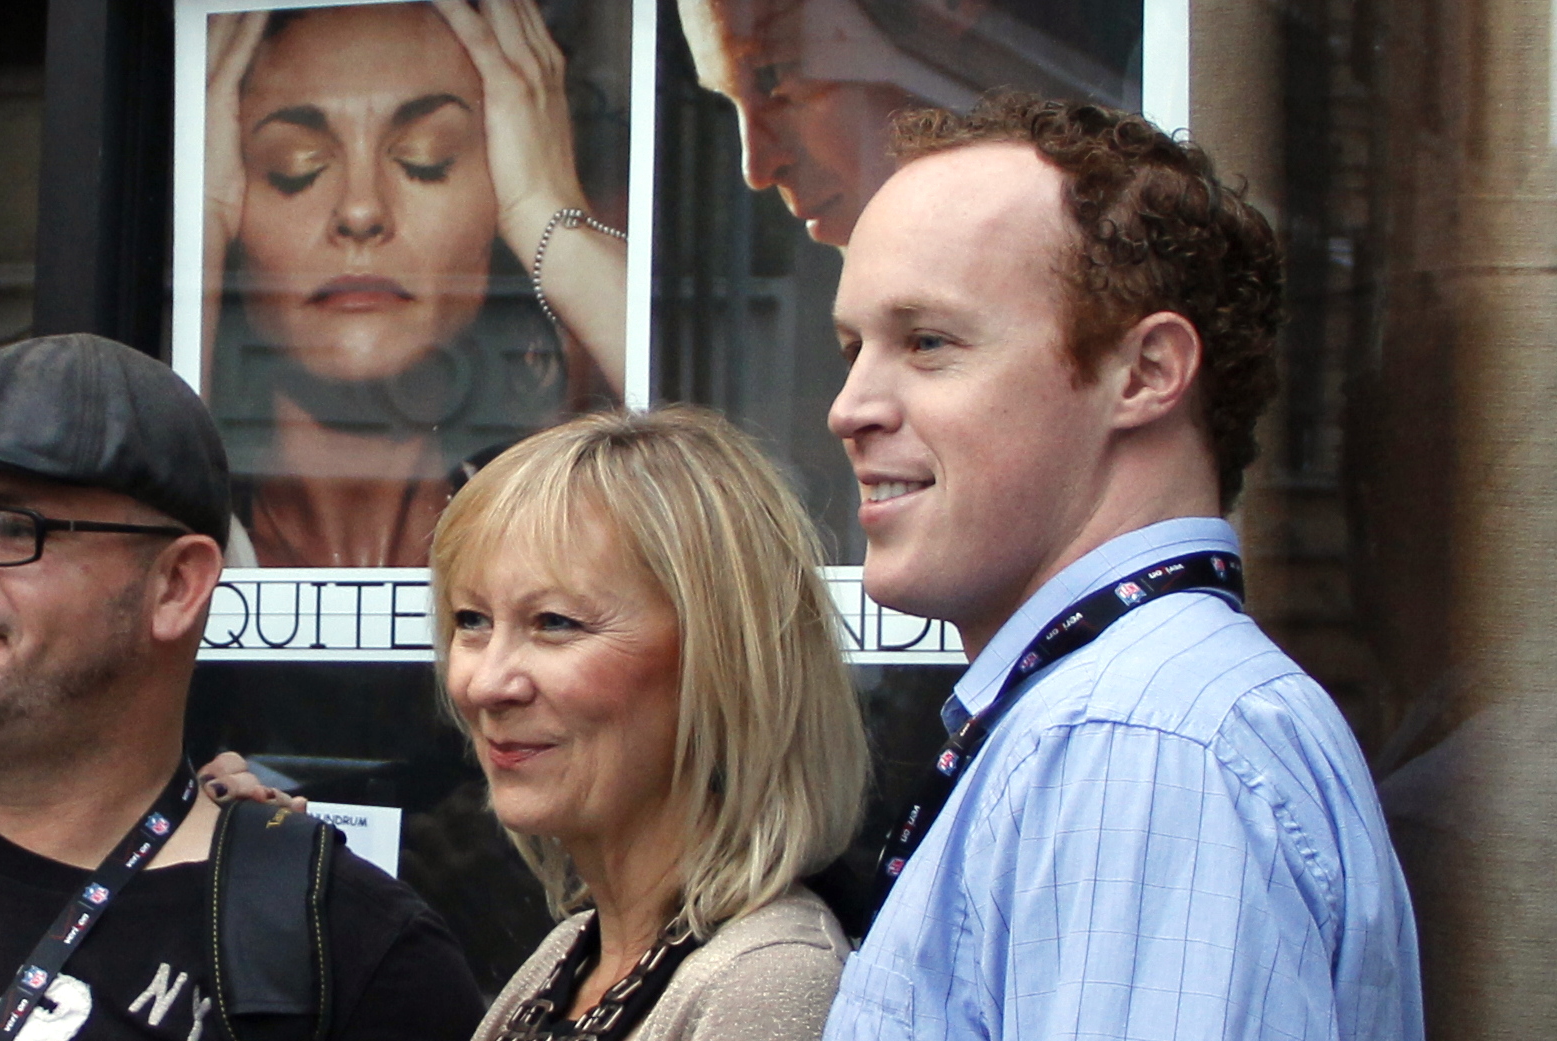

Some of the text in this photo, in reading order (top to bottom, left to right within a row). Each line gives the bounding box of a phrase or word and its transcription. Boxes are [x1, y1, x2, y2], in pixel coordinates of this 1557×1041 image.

[202, 581, 435, 650] QUITE
[900, 804, 922, 844] verizon
[126, 842, 151, 868] verizon
[63, 913, 90, 945] verizon
[3, 998, 30, 1033] verizon
